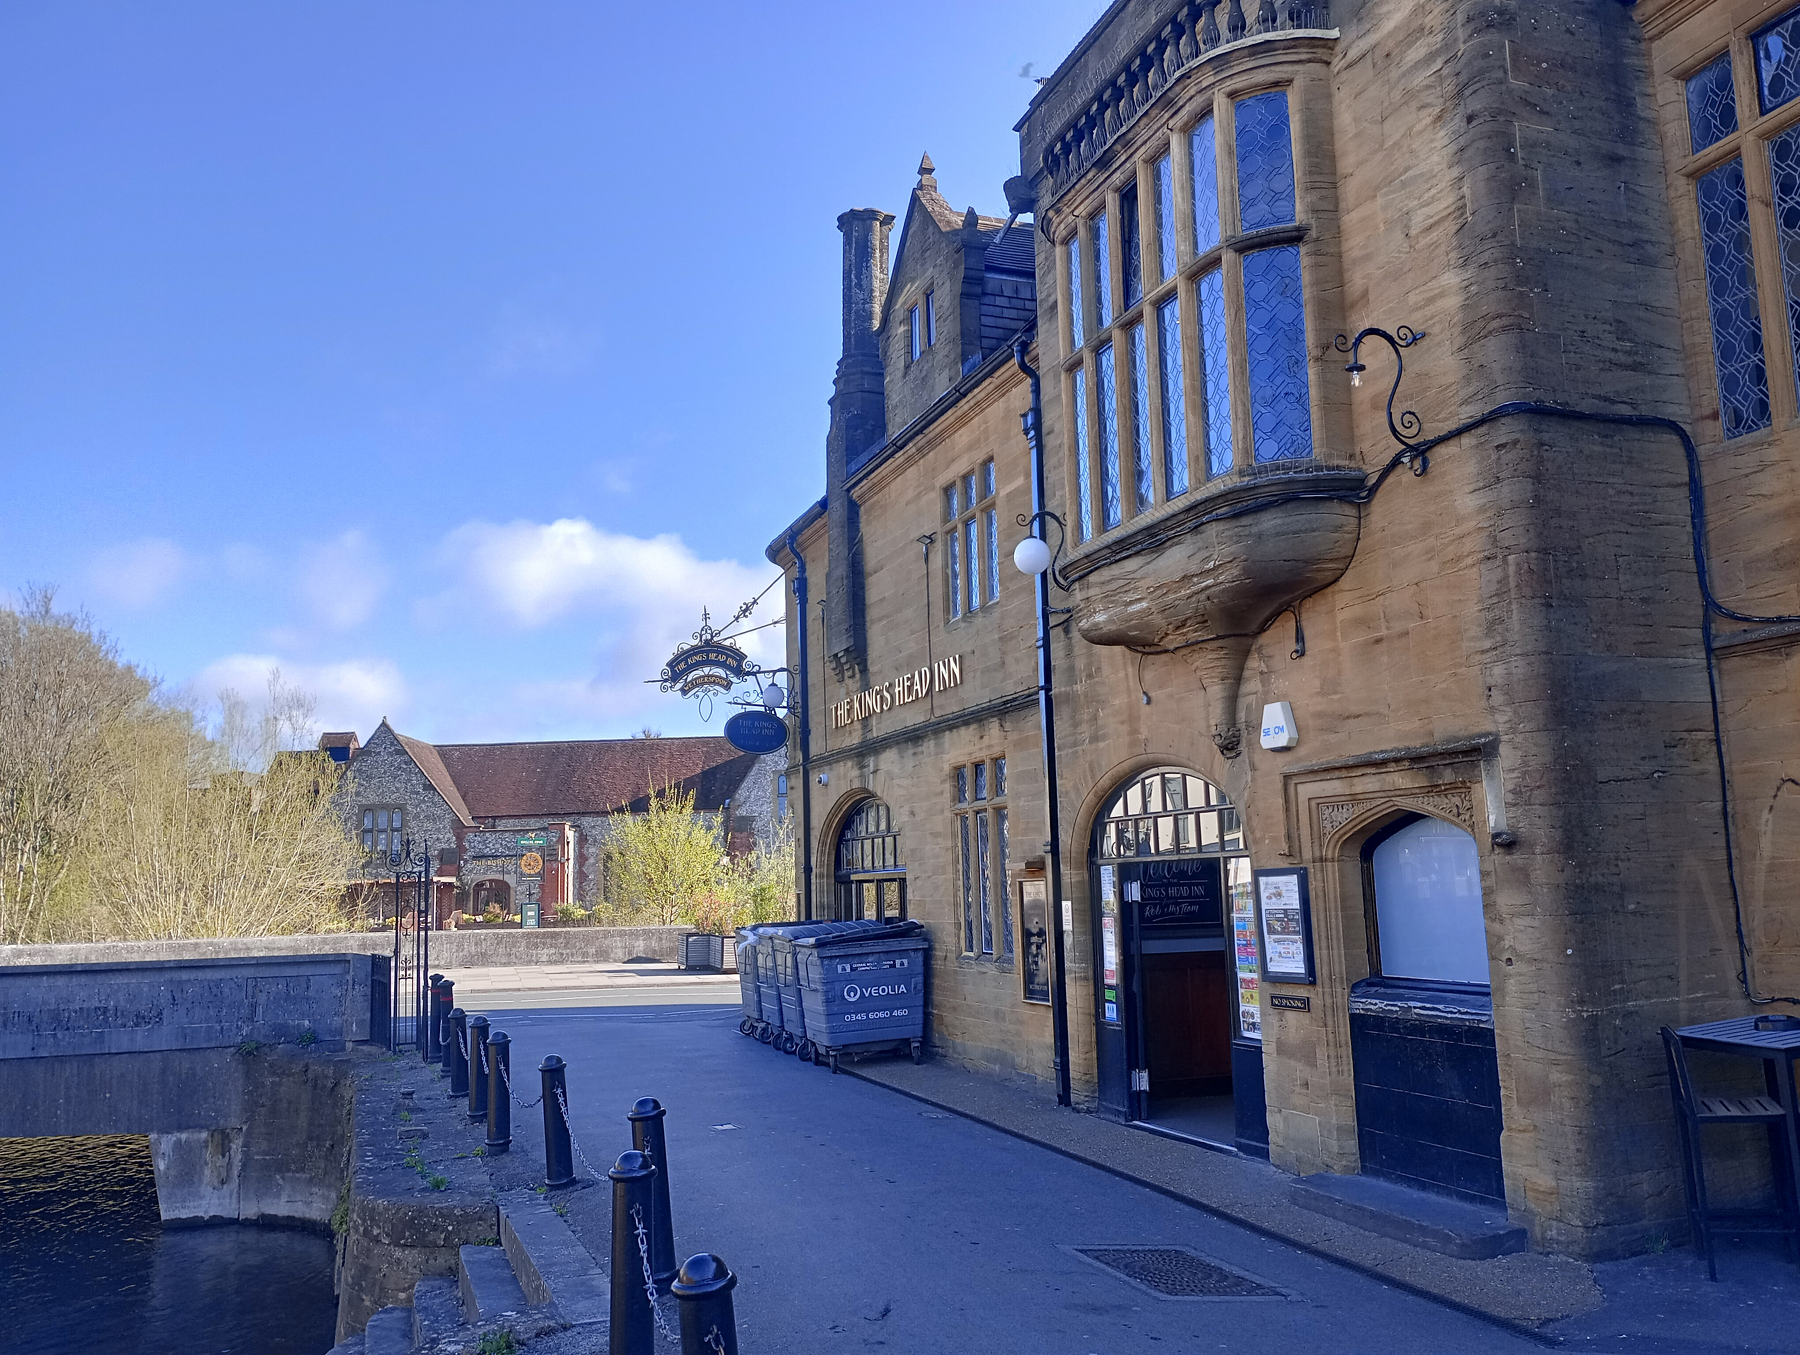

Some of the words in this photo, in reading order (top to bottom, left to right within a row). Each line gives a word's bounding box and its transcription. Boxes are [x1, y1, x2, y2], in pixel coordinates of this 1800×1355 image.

[674, 661, 688, 673] THE
[708, 652, 726, 662] HEAD
[726, 657, 738, 668] INN
[683, 676, 728, 691] WETHERSPOON
[830, 697, 852, 729] THE
[854, 681, 892, 721] KING'S
[894, 666, 931, 706] HEAD
[934, 654, 962, 692] INN
[739, 719, 753, 727] THE
[740, 727, 761, 735] HEAD
[762, 728, 775, 736] INN
[1168, 886, 1190, 897] HEAD
[1191, 885, 1205, 896] INN
[862, 984, 907, 997] VEOLIA
[844, 1013, 867, 1022] 0345
[868, 1010, 890, 1019] 6060
[892, 1008, 909, 1017] 460
